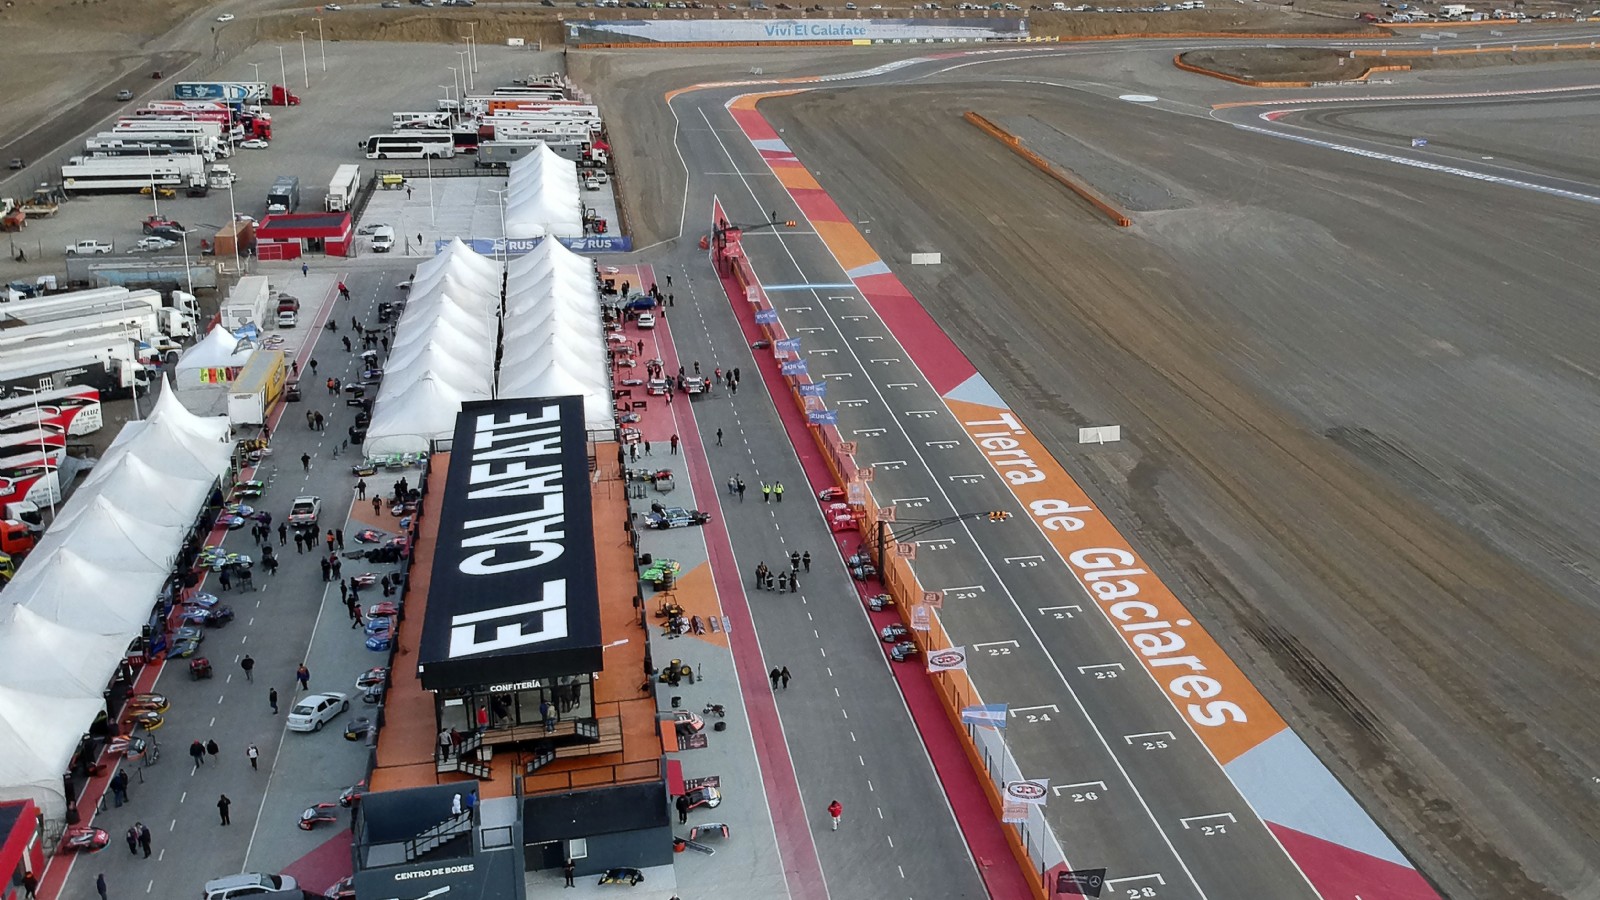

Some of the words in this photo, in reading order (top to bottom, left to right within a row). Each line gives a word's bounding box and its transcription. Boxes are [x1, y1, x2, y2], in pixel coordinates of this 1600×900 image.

[795, 25, 807, 36] El
[811, 24, 866, 36] Calafate
[509, 240, 534, 250] RUS
[587, 237, 611, 248] RUS
[458, 404, 565, 575] CALAFATE
[965, 412, 1046, 486] Tierra
[1028, 499, 1093, 532] de
[1069, 547, 1248, 727] Glaciares
[449, 578, 568, 658] EL
[988, 647, 1012, 656] 22
[1095, 670, 1118, 679] 23
[490, 679, 541, 692] CONFITERÍA
[1026, 713, 1052, 723] 24
[1142, 740, 1169, 750] 25
[1071, 791, 1099, 803] 26
[1201, 824, 1227, 836] 27
[395, 869, 430, 881] CENTRO
[432, 868, 444, 876] DE
[445, 863, 475, 875] BOXES
[1126, 887, 1157, 900] 28
